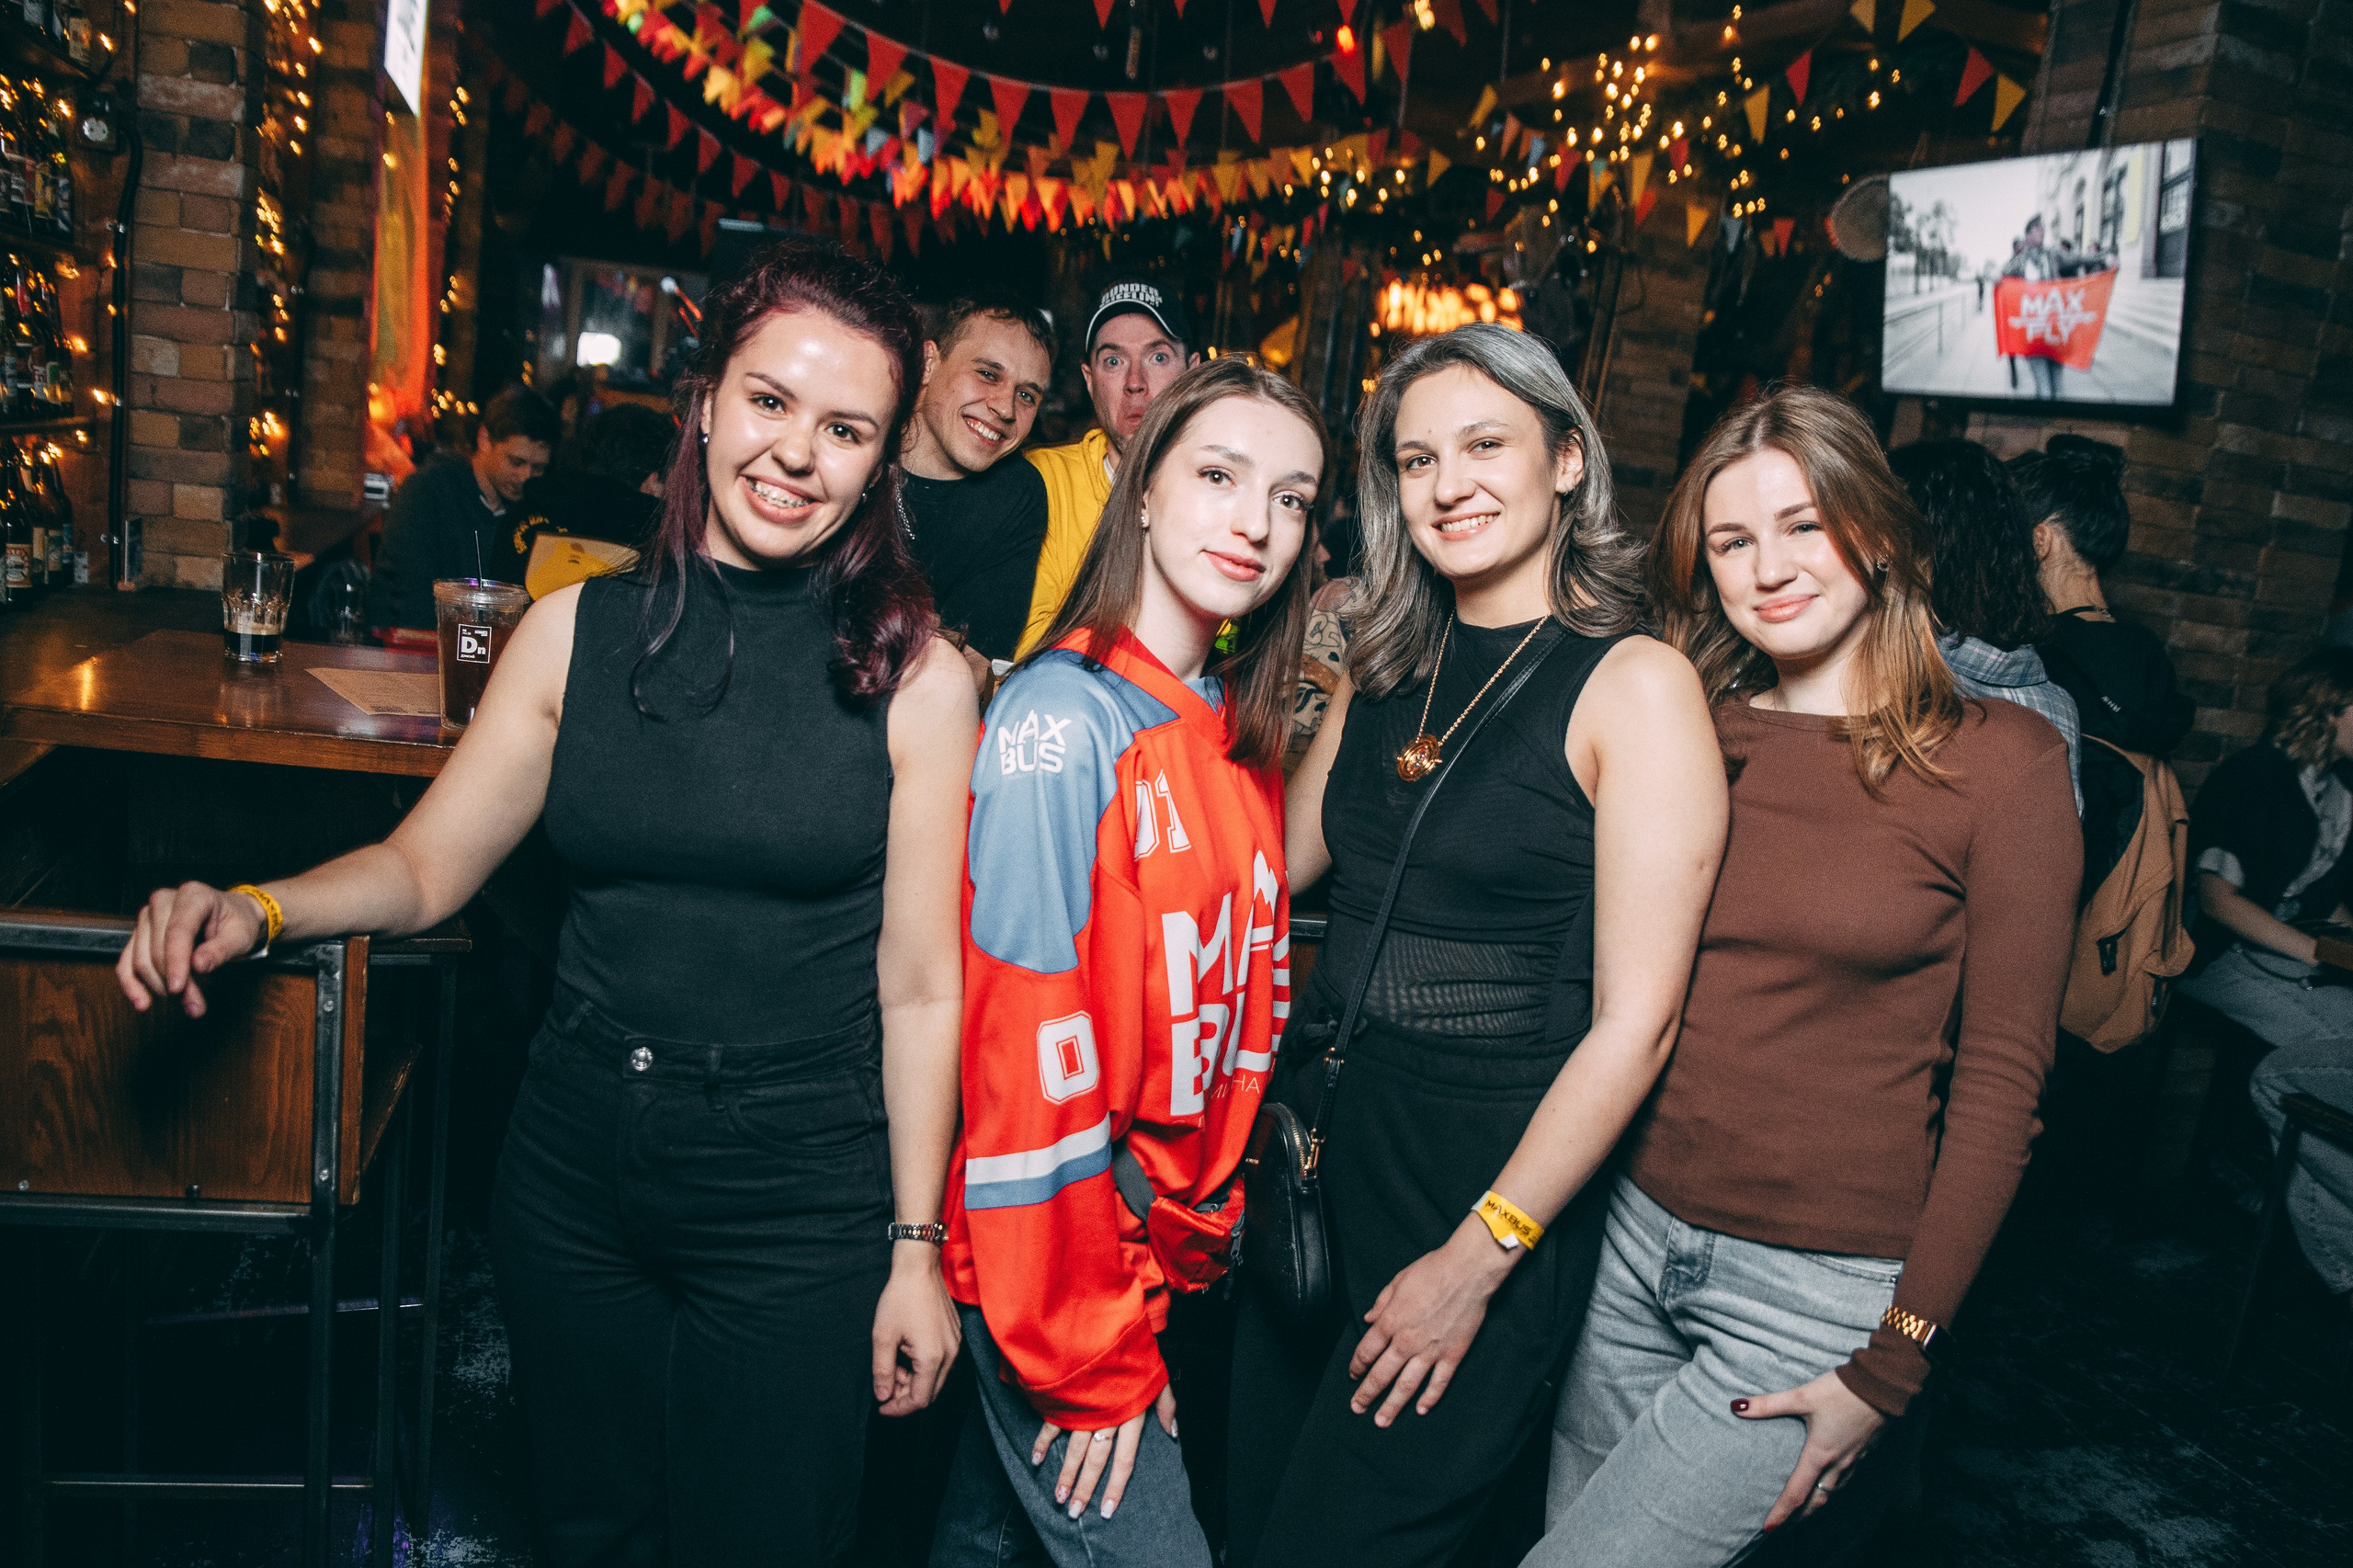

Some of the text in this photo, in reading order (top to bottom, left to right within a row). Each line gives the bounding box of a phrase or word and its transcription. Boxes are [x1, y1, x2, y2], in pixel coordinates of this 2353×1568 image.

[2021, 289, 2084, 319] MAX
[460, 636, 486, 654] Dn
[1000, 740, 1066, 776] BUS
[1485, 1199, 1532, 1235] MAXBUS
